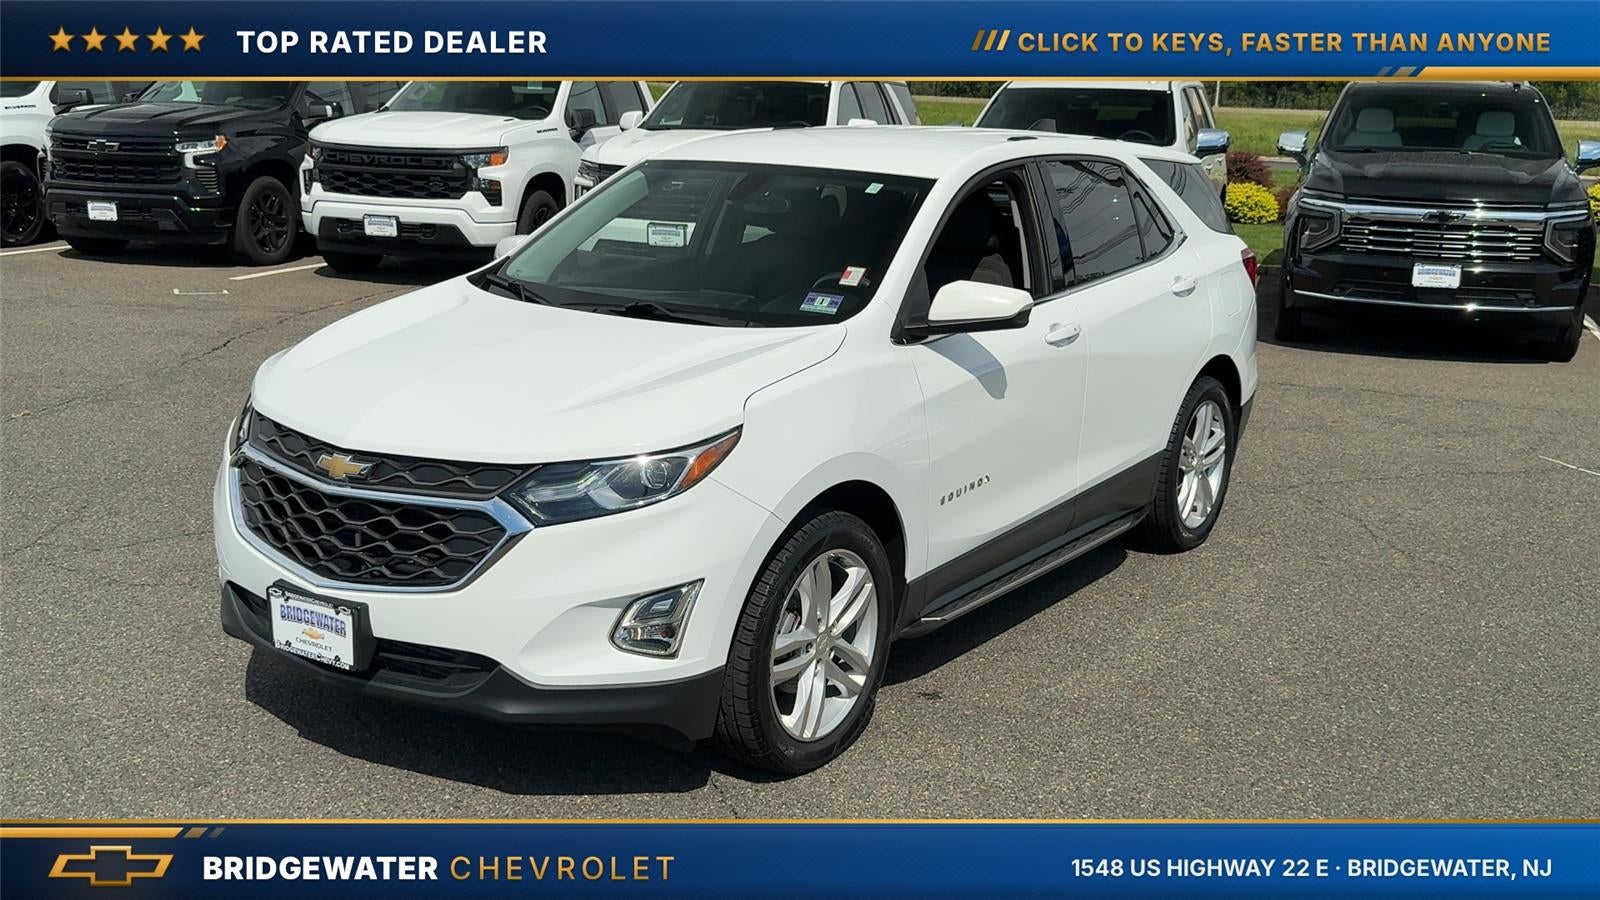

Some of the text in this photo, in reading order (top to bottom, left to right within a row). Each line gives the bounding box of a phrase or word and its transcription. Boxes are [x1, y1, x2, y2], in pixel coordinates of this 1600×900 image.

[325, 151, 454, 168] CHEVROLET
[940, 473, 991, 506] EQUINOX
[280, 604, 347, 637] BRIDGEWATER
[296, 637, 332, 652] CHEVROLET
